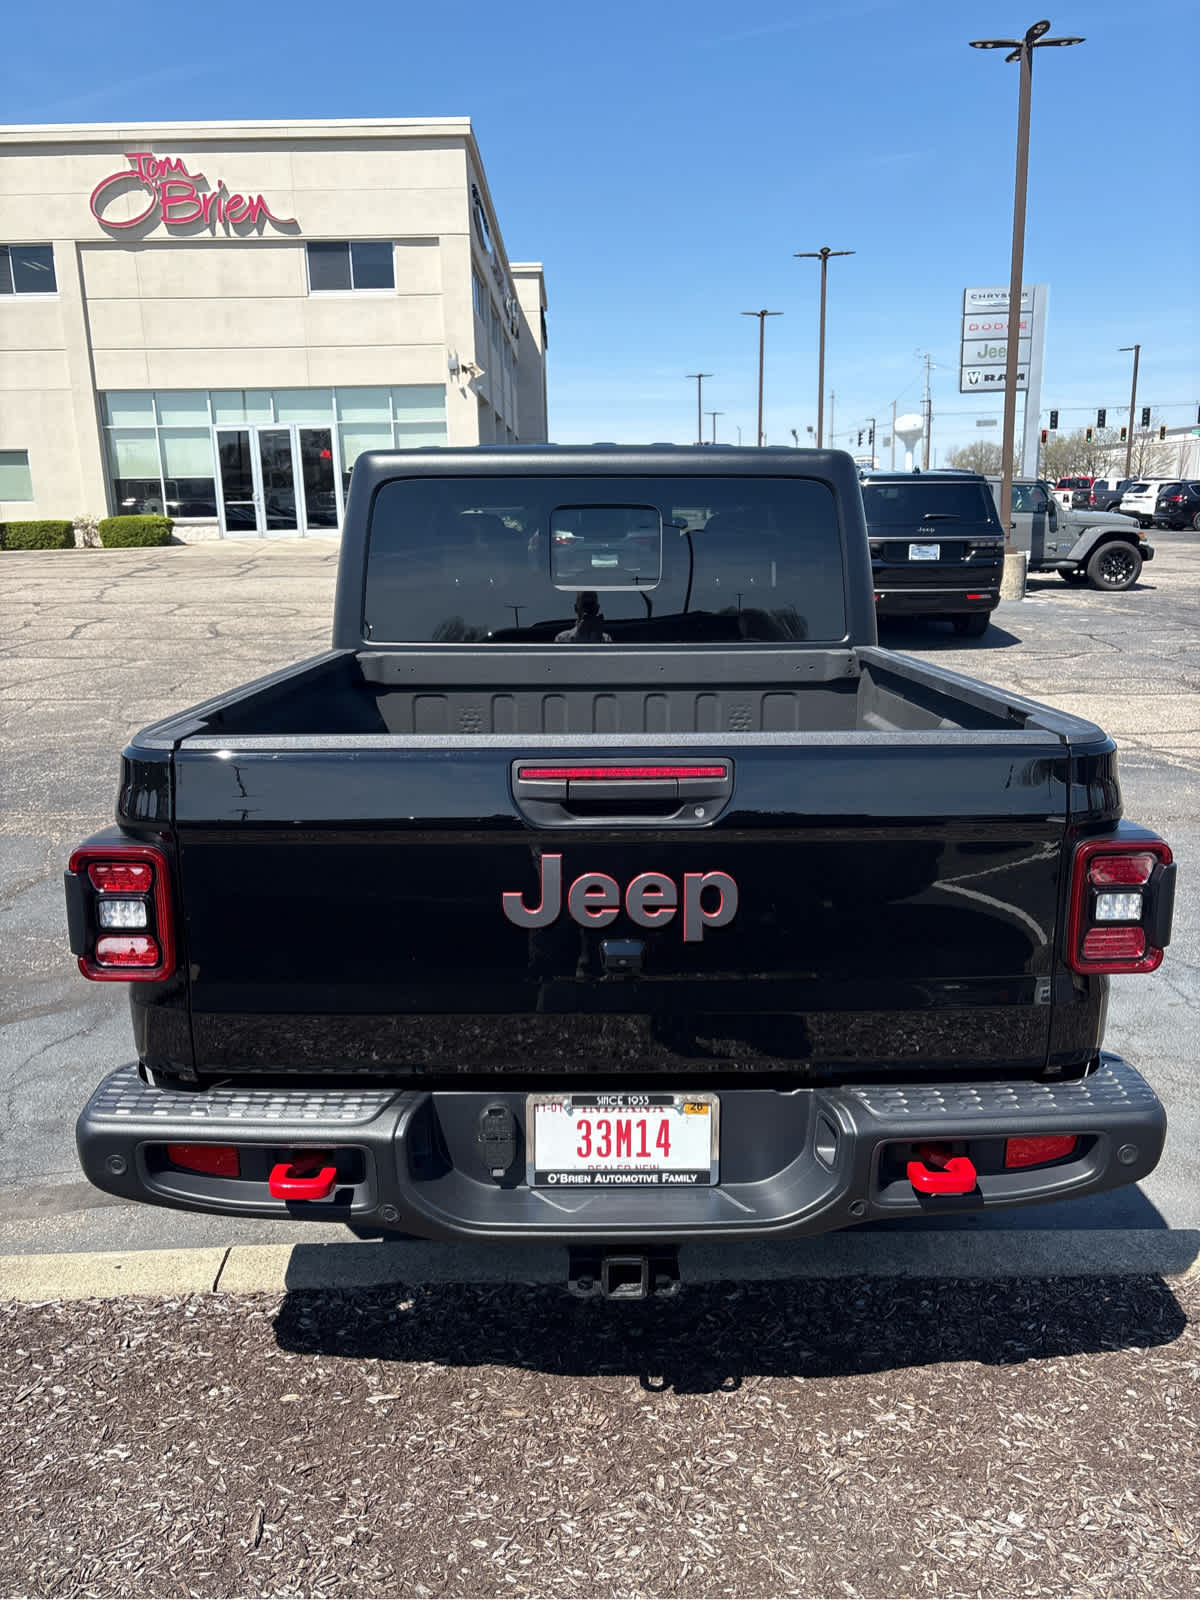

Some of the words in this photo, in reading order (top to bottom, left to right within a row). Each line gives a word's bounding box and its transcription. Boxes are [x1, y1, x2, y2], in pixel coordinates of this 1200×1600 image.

[124, 153, 204, 182] Tom
[90, 170, 296, 228] O'Brien
[968, 321, 1027, 331] DODE
[977, 343, 1008, 359] Jee
[502, 853, 739, 941] Jeep
[596, 1096, 625, 1105] SINCE
[576, 1119, 671, 1158] 33M14
[547, 1173, 591, 1184] O'BRIEN
[594, 1173, 658, 1184] AUTOMOTIVE
[661, 1173, 698, 1183] FAMILY
